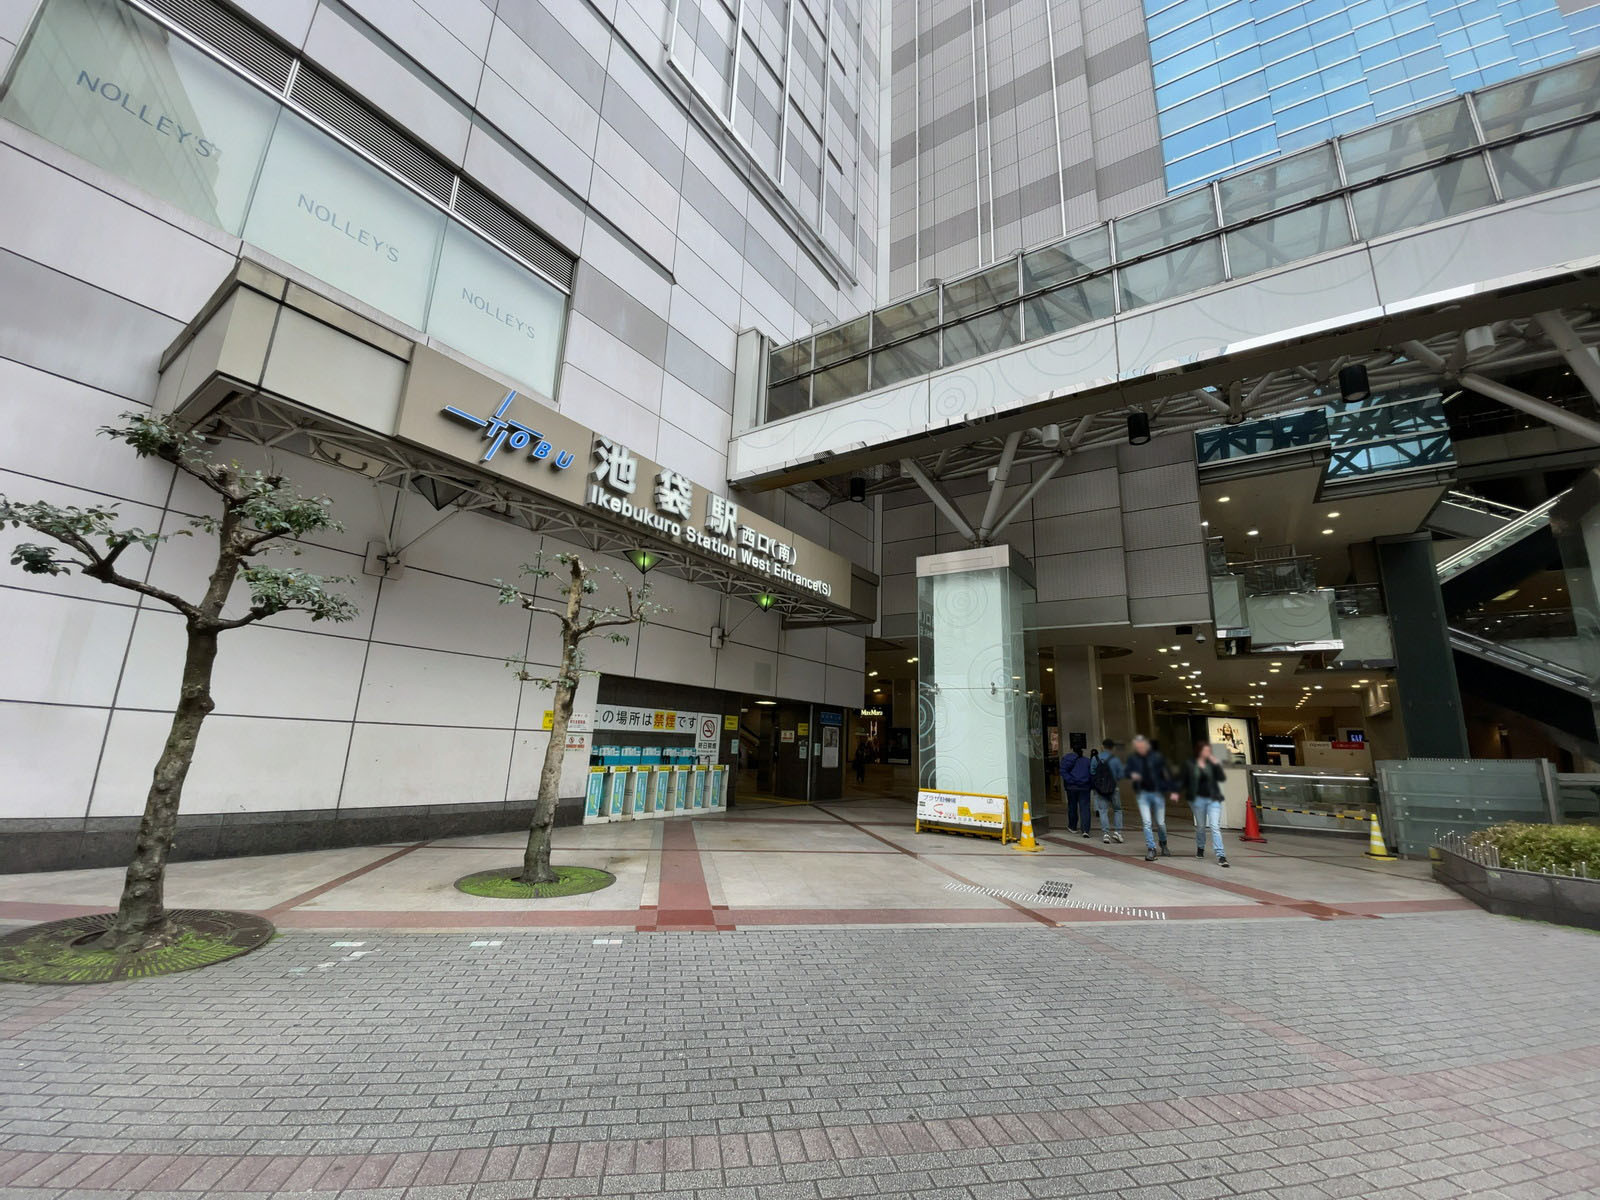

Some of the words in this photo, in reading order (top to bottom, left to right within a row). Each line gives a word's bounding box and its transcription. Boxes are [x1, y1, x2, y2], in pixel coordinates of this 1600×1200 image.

[76, 69, 212, 159] NOLLEY'S
[297, 193, 400, 263] NOLLEY'S
[461, 287, 536, 340] NOLLEY'S
[590, 437, 739, 542] 池袋駅
[591, 485, 680, 536] Ikebukuro
[685, 528, 737, 562] Station
[740, 547, 770, 576] West
